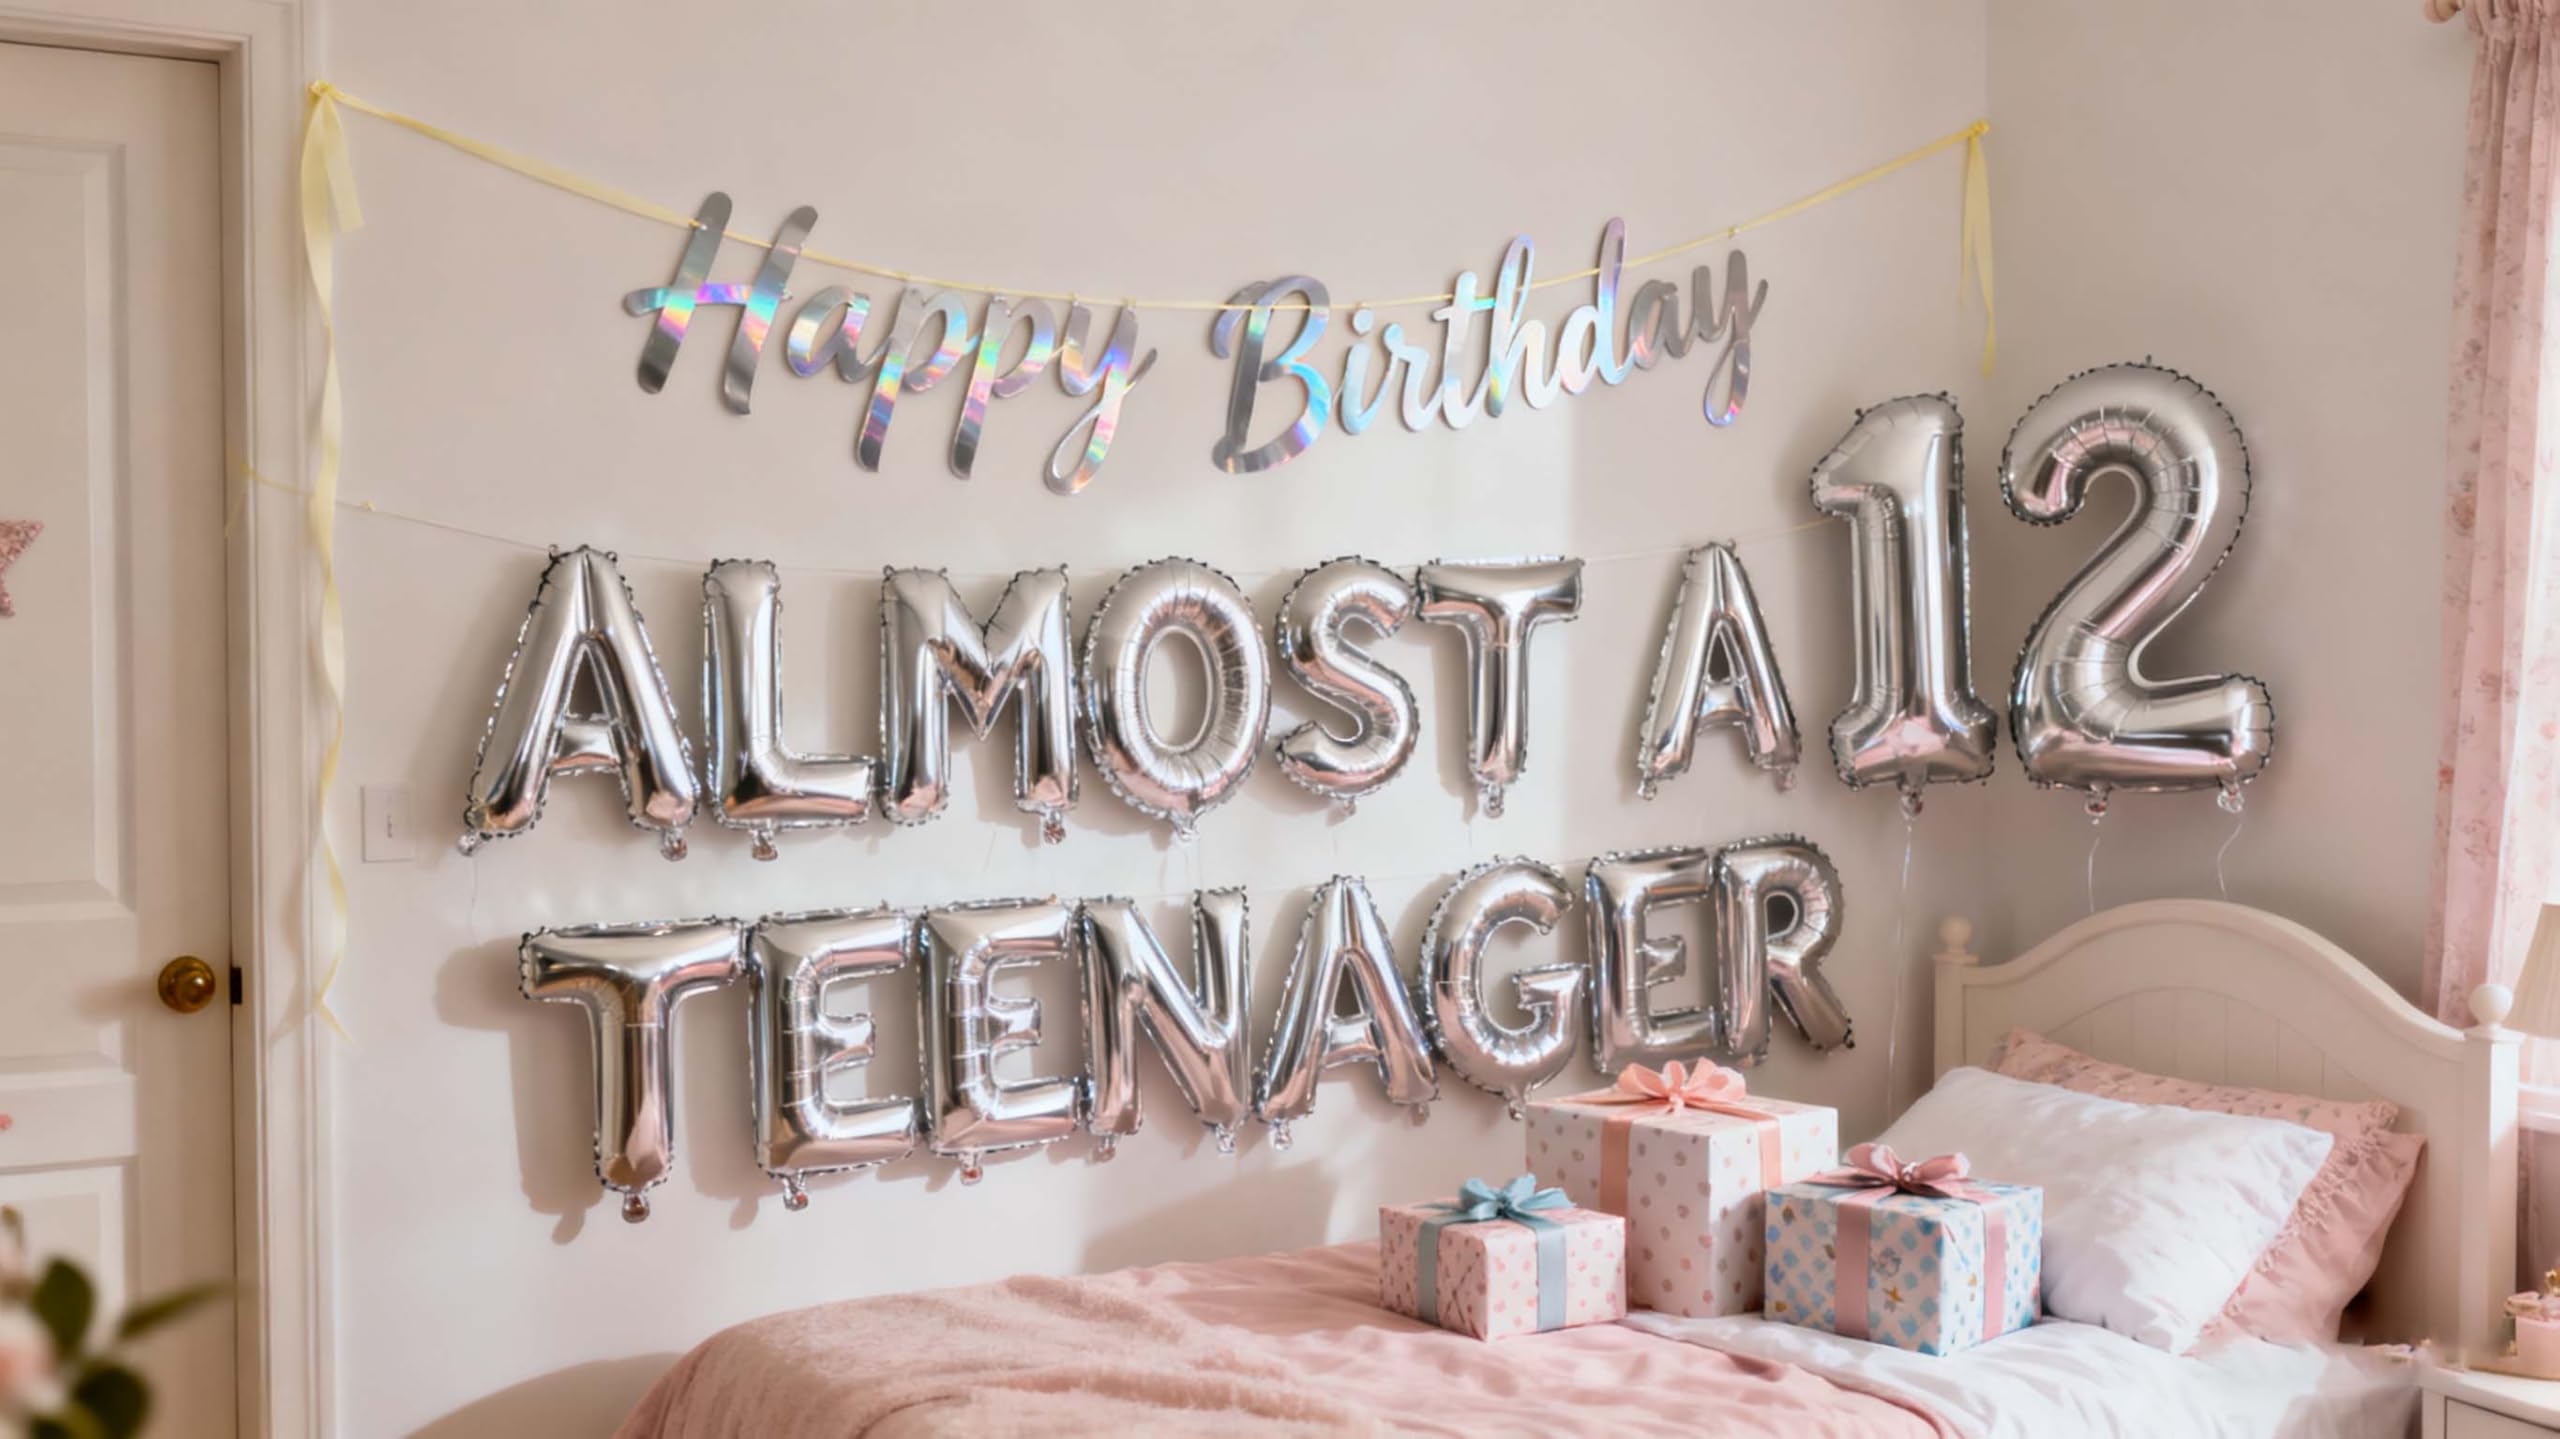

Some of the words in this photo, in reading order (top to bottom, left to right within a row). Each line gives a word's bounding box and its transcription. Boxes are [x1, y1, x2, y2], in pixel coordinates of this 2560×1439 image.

[622, 191, 1157, 494] Happy
[1212, 217, 1768, 474] Birthday
[460, 544, 1584, 855] ALMOST
[1638, 540, 1801, 796] A
[1810, 356, 2275, 812] 12
[518, 833, 1855, 1218] TEENAGER
